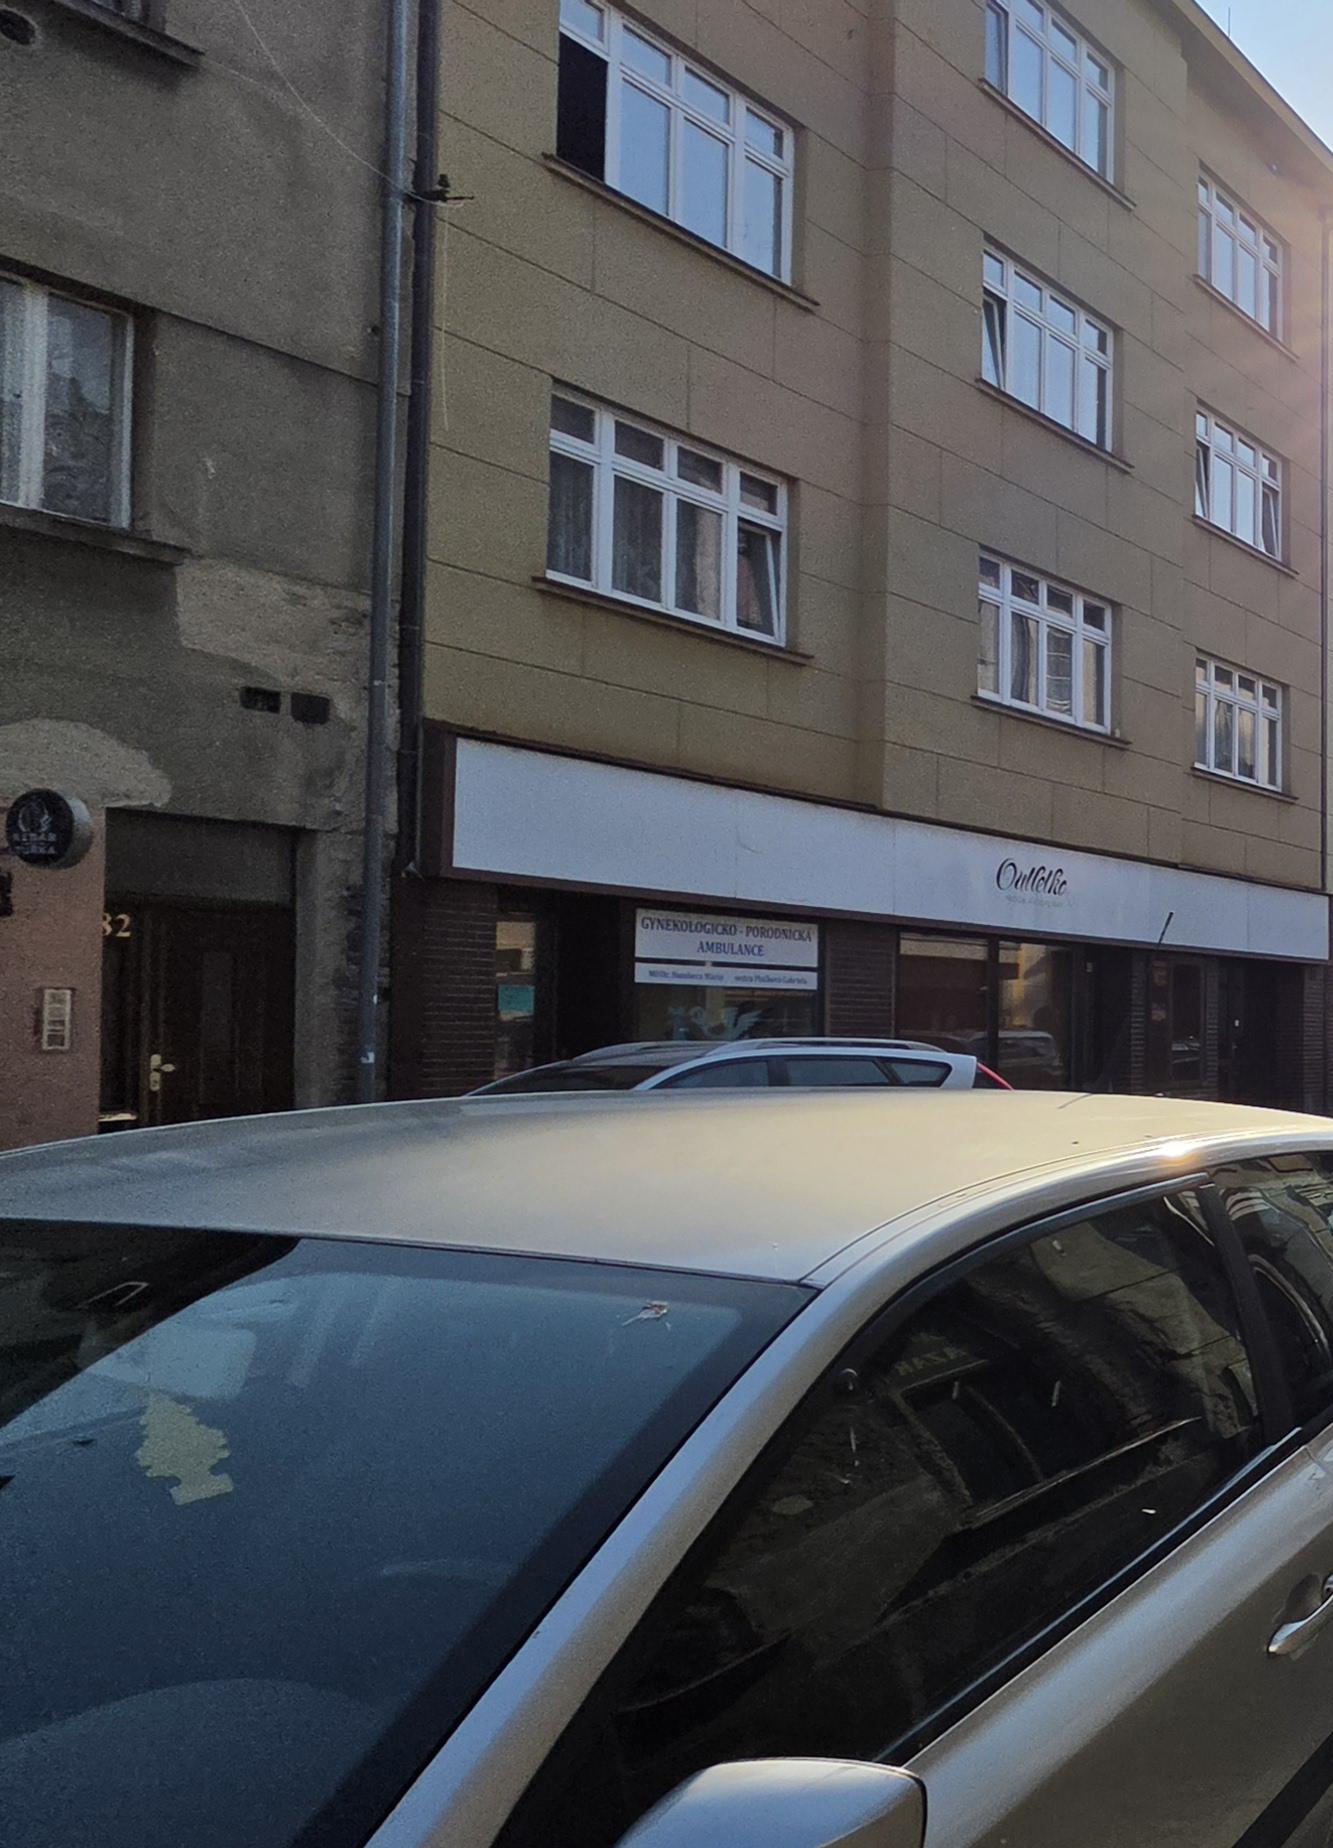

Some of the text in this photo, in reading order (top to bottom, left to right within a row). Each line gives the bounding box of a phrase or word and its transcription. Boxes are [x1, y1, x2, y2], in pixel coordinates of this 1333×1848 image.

[641, 916, 737, 937] GYNEKOLOGICKO
[745, 925, 813, 942] PORODNICKÁ
[697, 941, 765, 957] AMBULANCE
